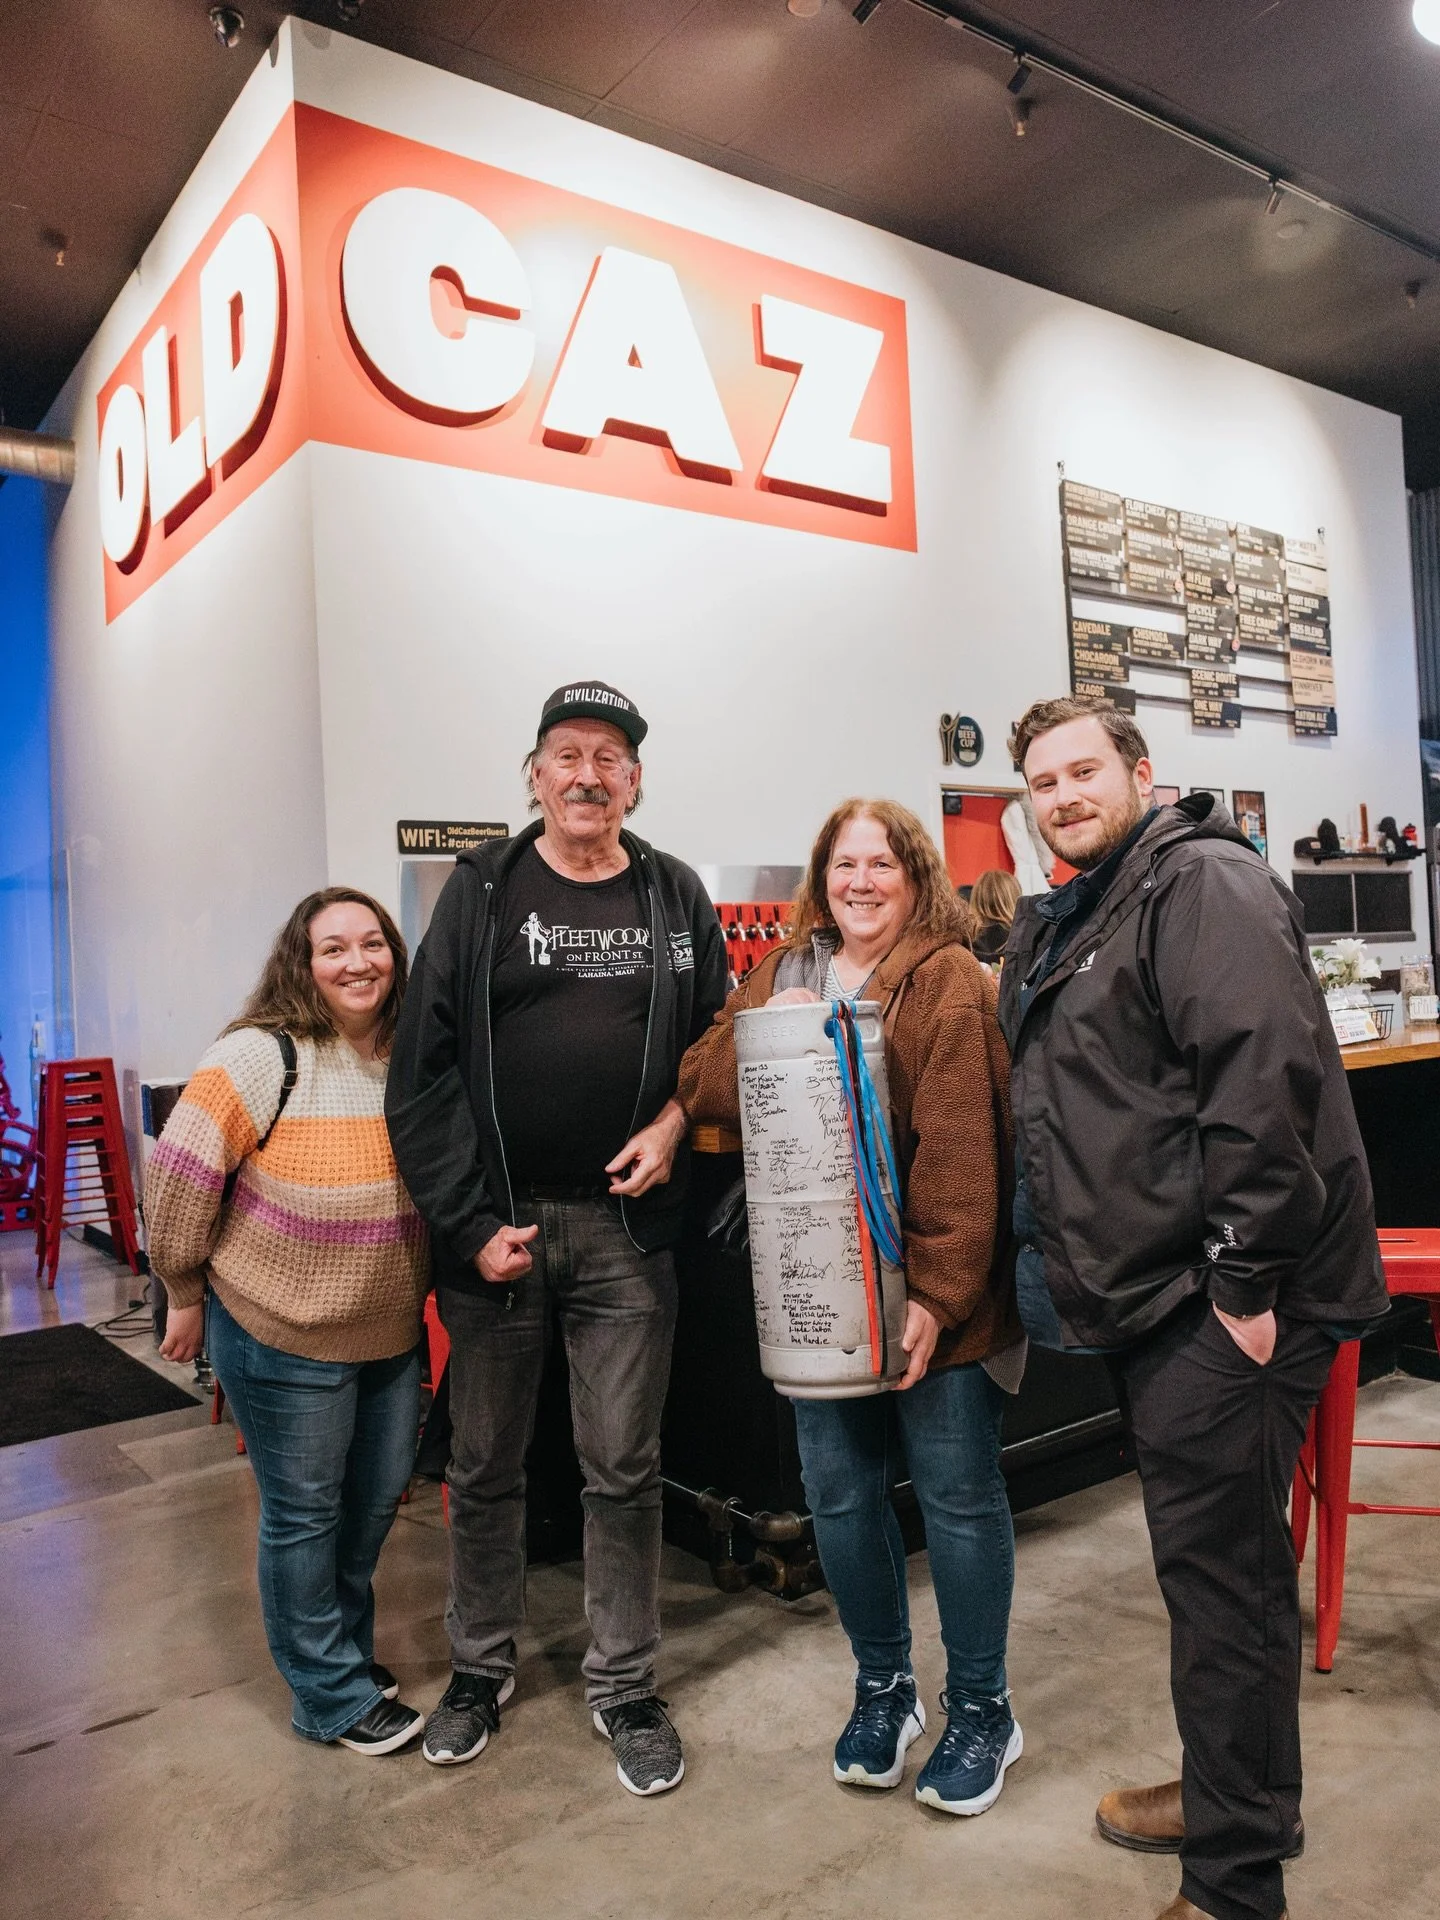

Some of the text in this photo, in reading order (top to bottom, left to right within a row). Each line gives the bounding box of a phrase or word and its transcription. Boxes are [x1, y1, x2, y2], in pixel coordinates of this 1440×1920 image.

[99, 187, 893, 568] OLD CAZ
[1187, 603, 1217, 618] UPCYCLE
[1073, 621, 1111, 636] CAVEDALE
[1132, 627, 1169, 643] CHISMOSA
[1189, 632, 1207, 646] DARK
[1074, 649, 1119, 666] CHOCAROON
[1191, 669, 1238, 685] SCENIC ROUTE
[1075, 683, 1105, 697] SKAGGS
[564, 688, 630, 711] CIVILIZATION
[958, 730, 976, 739] BEER
[960, 739, 975, 748] CUP
[400, 828, 447, 848] WIFI:
[584, 950, 631, 962] FRONT
[632, 951, 644, 959] ST.
